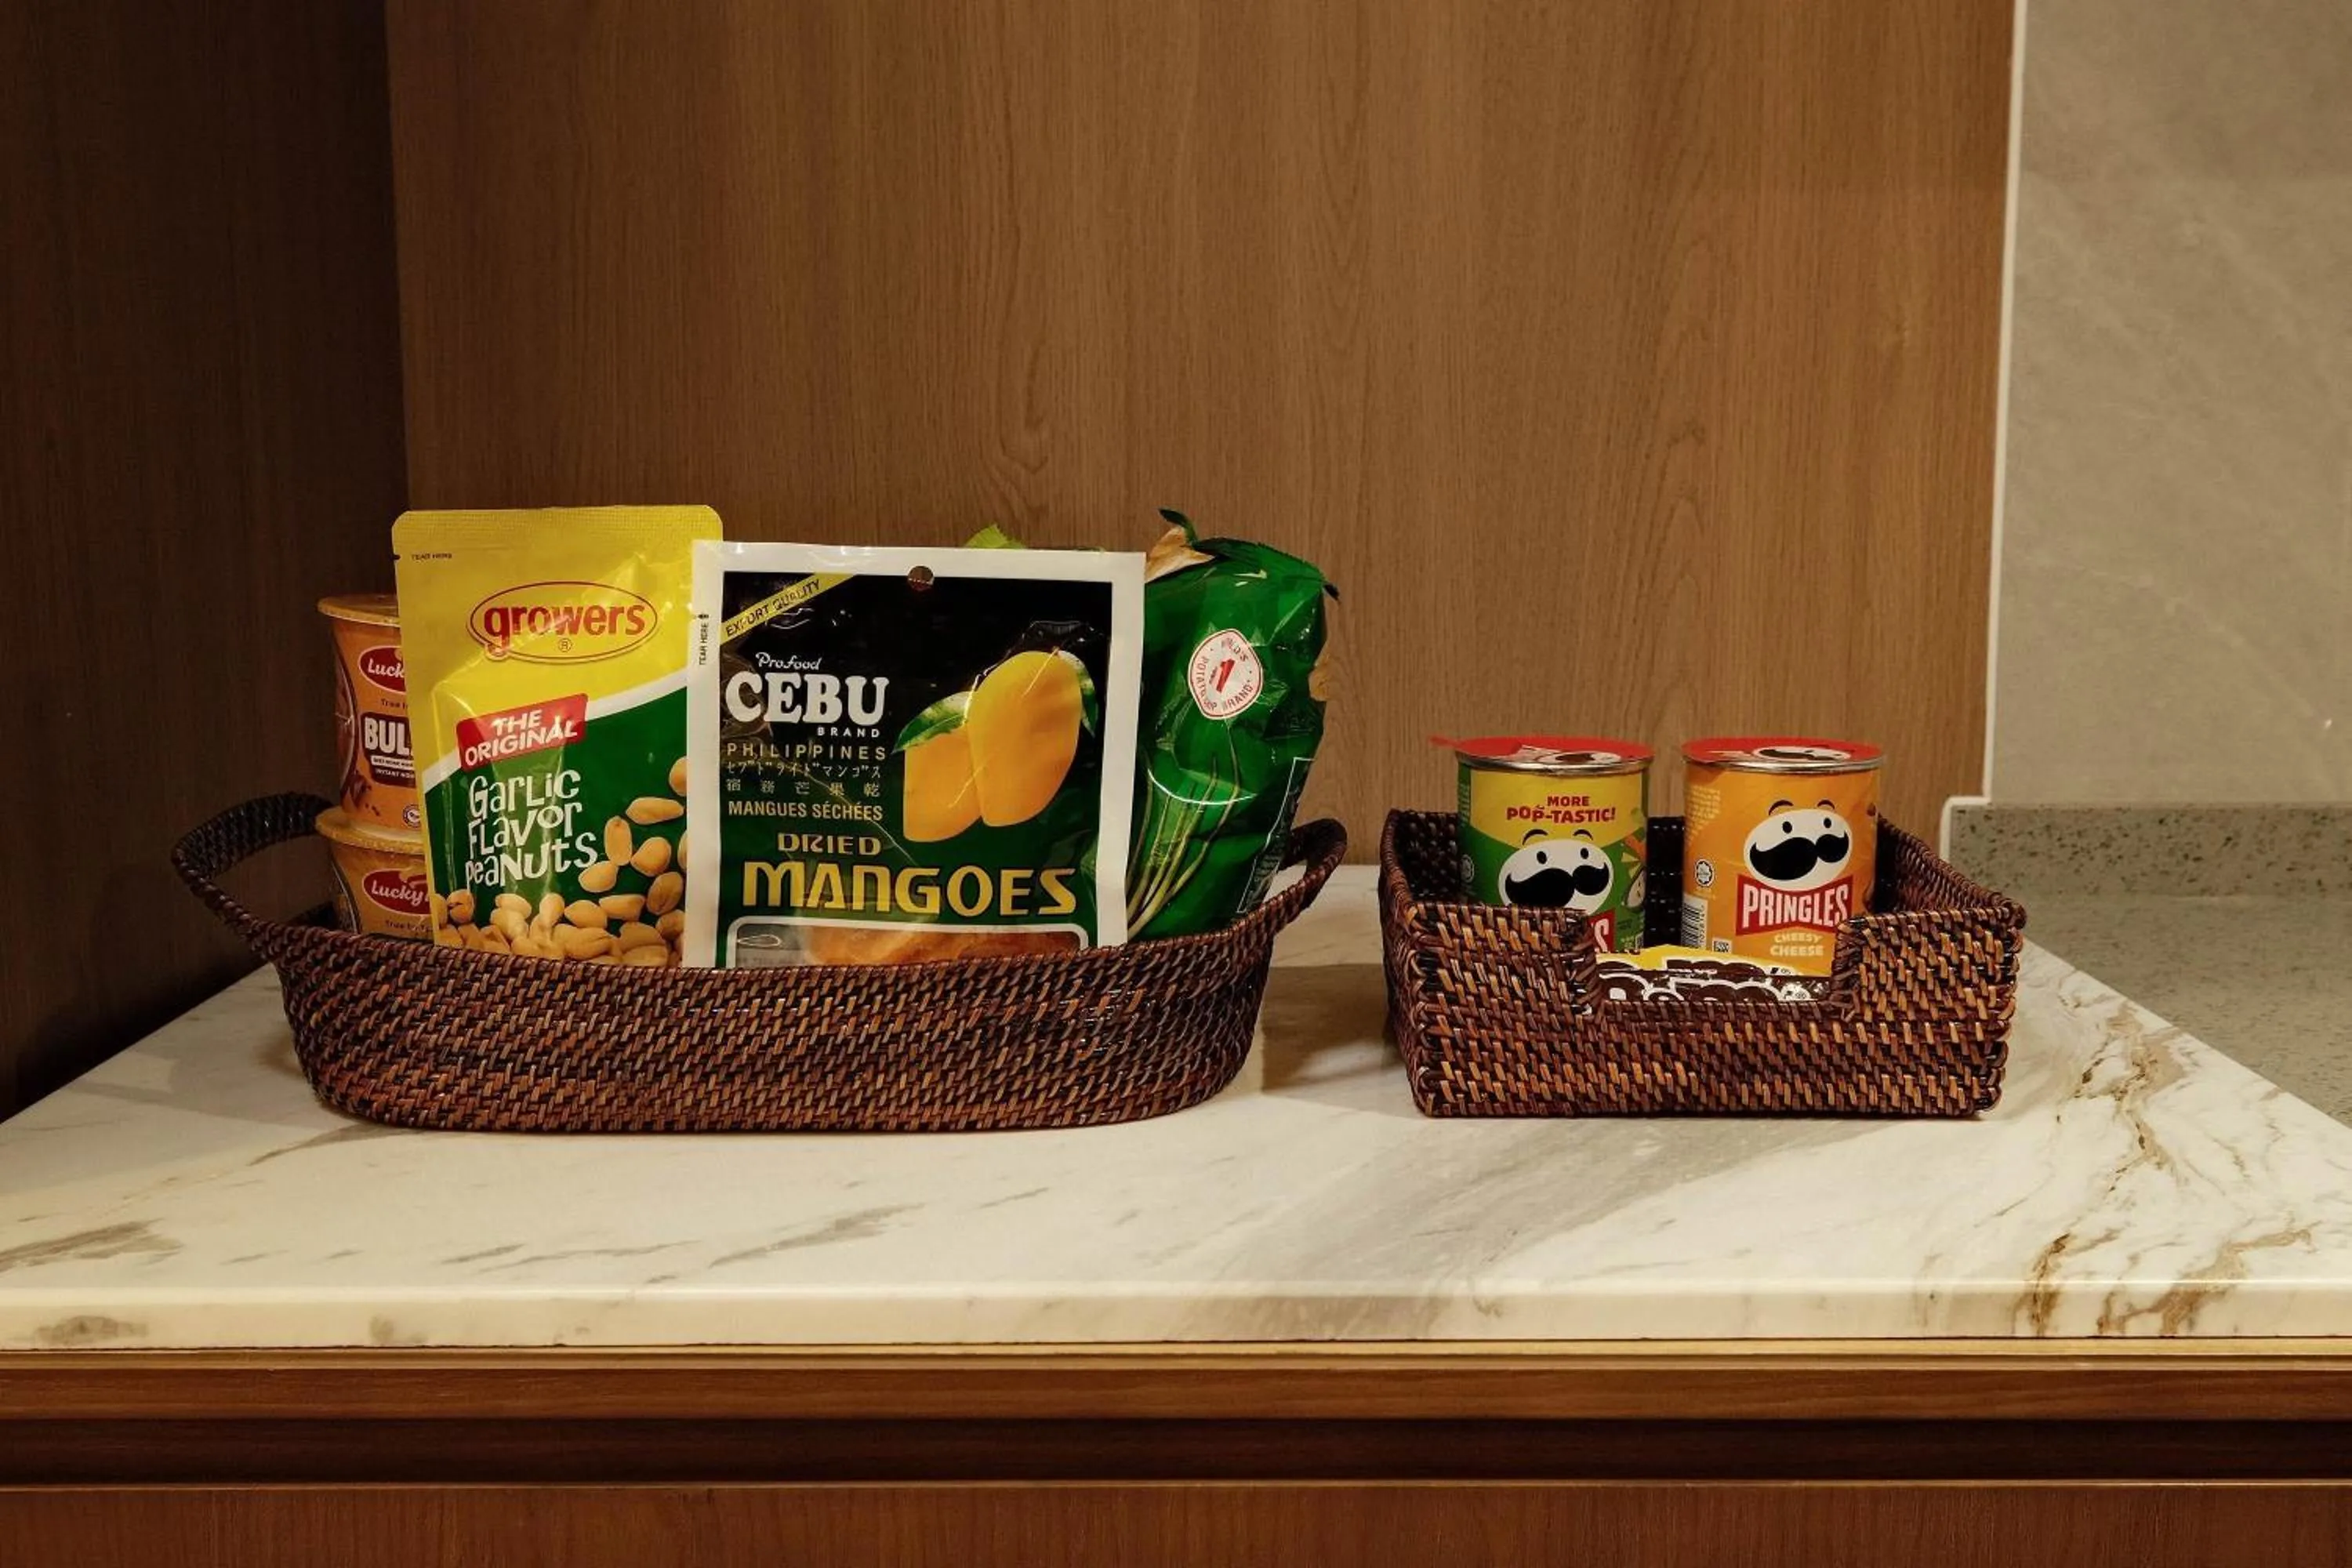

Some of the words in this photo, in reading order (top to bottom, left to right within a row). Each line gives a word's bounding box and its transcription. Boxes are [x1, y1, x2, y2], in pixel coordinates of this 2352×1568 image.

[726, 604, 769, 637] EXPORT
[772, 579, 821, 610] QUALITY
[484, 604, 646, 657] growers
[368, 658, 405, 678] Luck
[725, 670, 890, 726] CEBU
[492, 710, 543, 736] THE
[817, 727, 880, 738] BRAND
[365, 717, 414, 757] BUL
[465, 714, 578, 766] ORIGINAL
[727, 743, 886, 760] PHILIPPINES
[728, 800, 808, 818] MANGUES
[811, 800, 884, 822] SÉCHÉES
[1547, 796, 1591, 808] MORE
[1506, 805, 1617, 824] POP-TASTIC!
[777, 833, 882, 855] DRIED
[372, 880, 423, 906] Lucky
[742, 860, 1078, 918] MANGOES
[1742, 884, 1849, 929] PRINGLES
[1773, 932, 1823, 944] CHEESY
[1769, 945, 1824, 956] CHEESE
